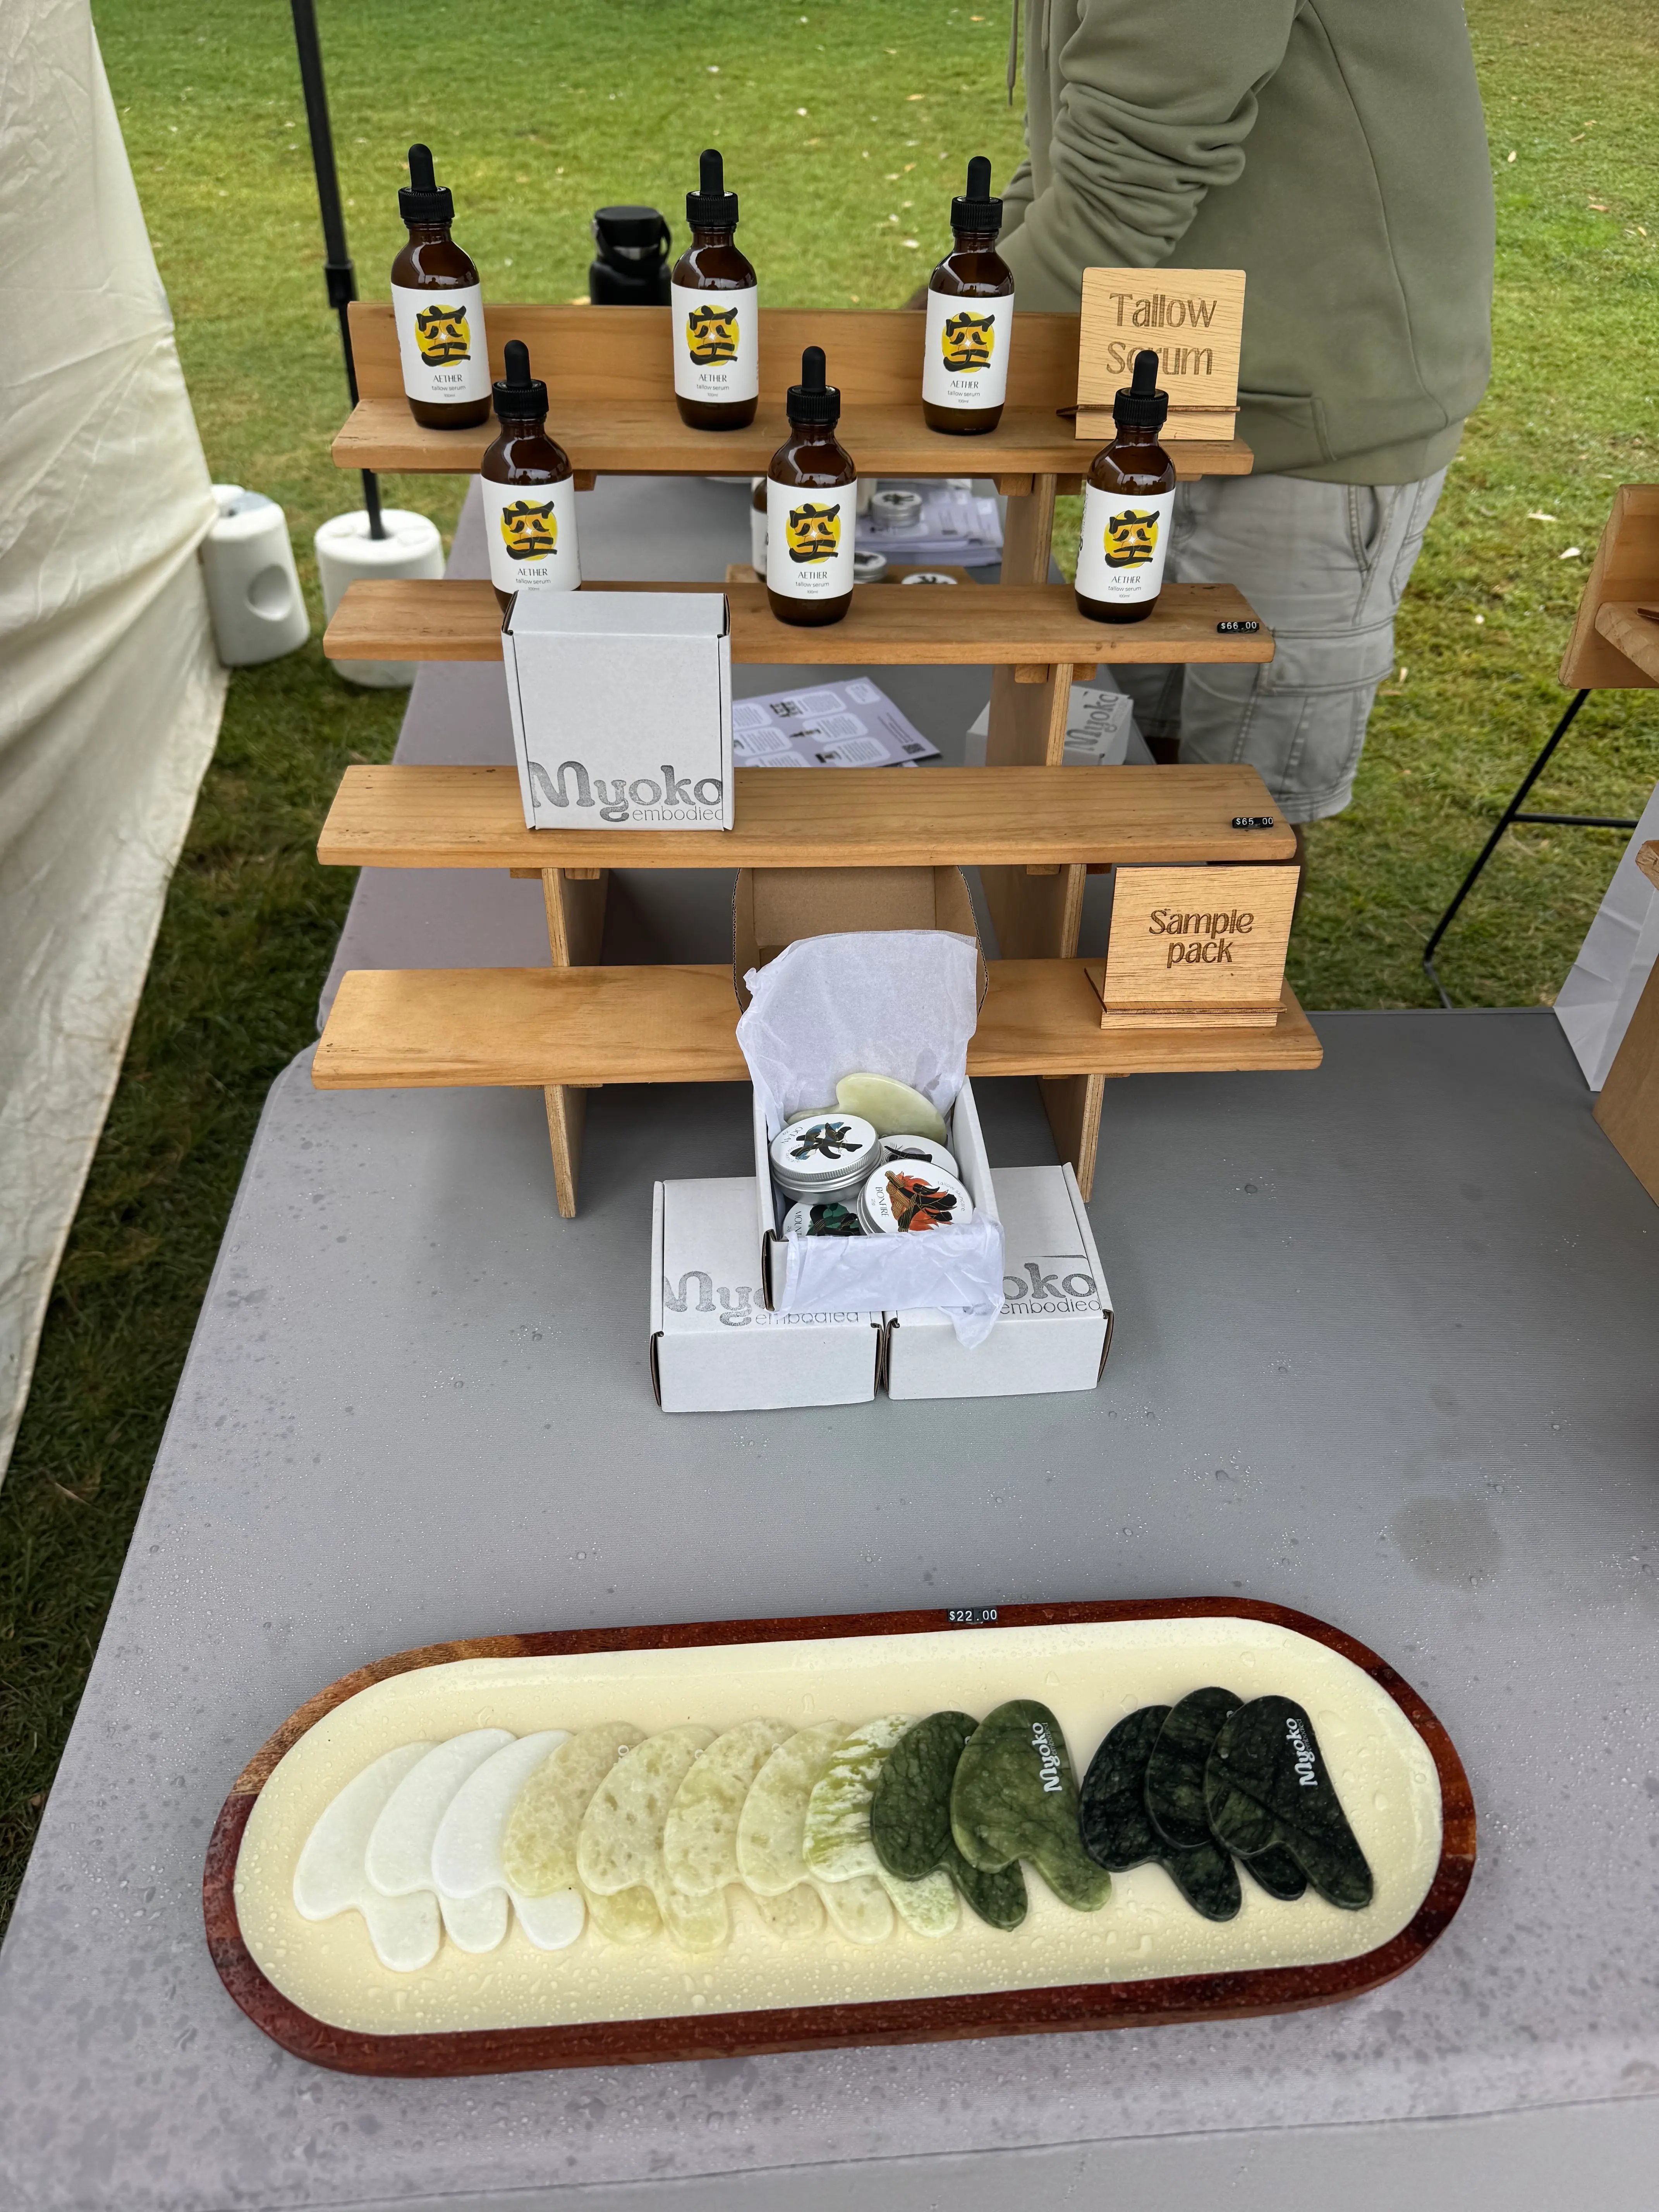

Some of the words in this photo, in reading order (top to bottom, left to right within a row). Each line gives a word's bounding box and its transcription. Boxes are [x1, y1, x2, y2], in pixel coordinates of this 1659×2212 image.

[1109, 293, 1217, 327] Tallow
[433, 374, 463, 382] AETHER
[950, 380, 979, 388] AETHER
[1064, 694, 1118, 751] Myoko
[528, 761, 722, 822] Myoko
[1149, 909, 1254, 939] Sample
[1167, 938, 1233, 968] pack
[876, 1187, 889, 1217] BONFIRE
[938, 1181, 955, 1190] tallow
[955, 1190, 965, 1211] skincare
[1003, 1262, 1096, 1300] oko
[1000, 1298, 1101, 1314] embodied
[949, 1609, 997, 1621] $22.00
[1042, 1723, 1057, 1755] embodied
[1295, 1719, 1312, 1751] embodied
[1032, 1723, 1062, 1792] Myoko
[1286, 1718, 1318, 1786] Myoko
